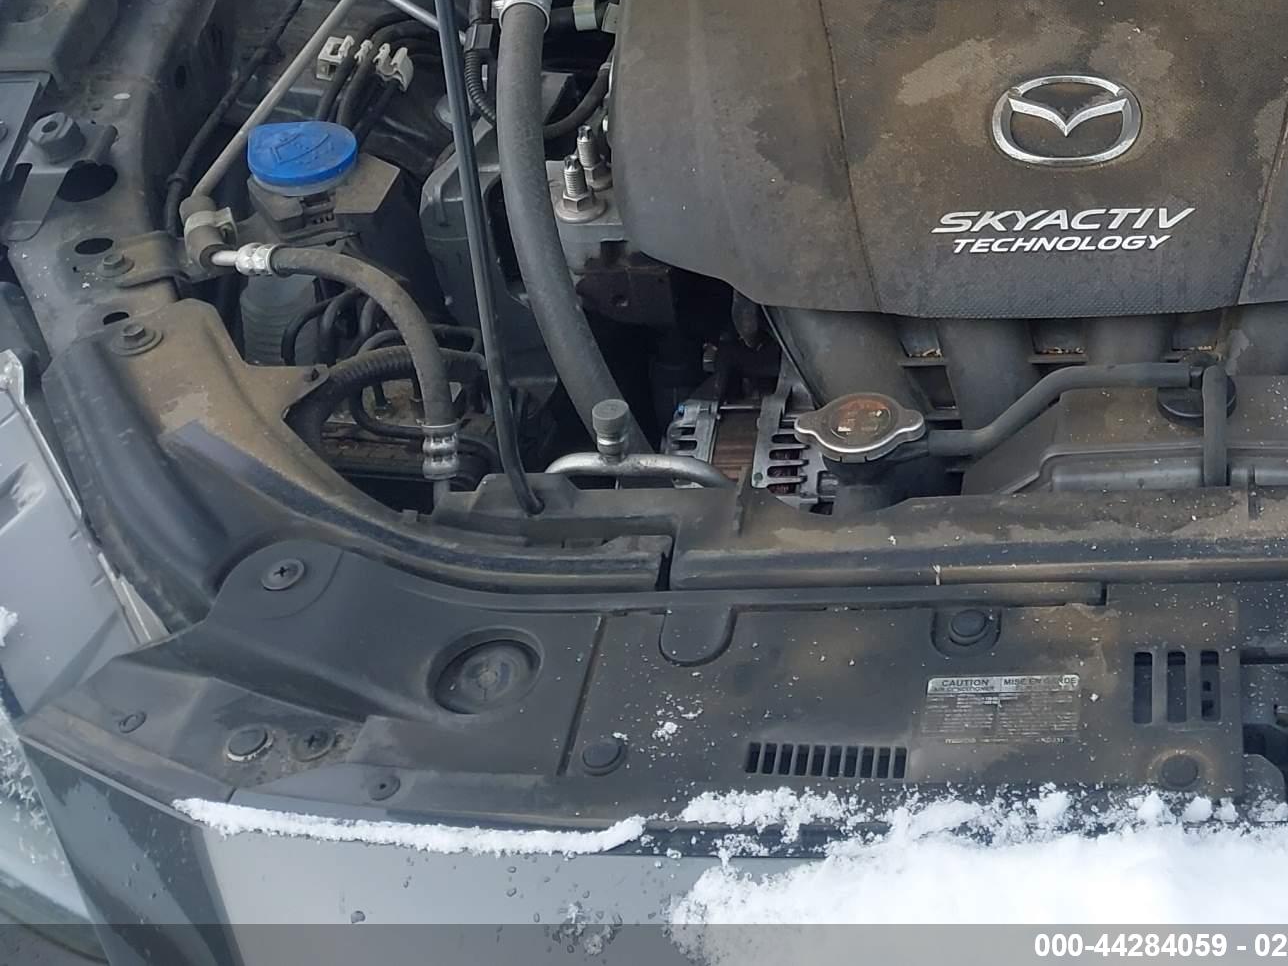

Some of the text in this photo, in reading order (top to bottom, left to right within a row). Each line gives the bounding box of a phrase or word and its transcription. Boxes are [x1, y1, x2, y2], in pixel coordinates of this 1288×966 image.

[932, 208, 1195, 233] SKYACTIV
[954, 235, 1170, 253] TECHNOLOGY
[941, 679, 989, 687] CAUTION
